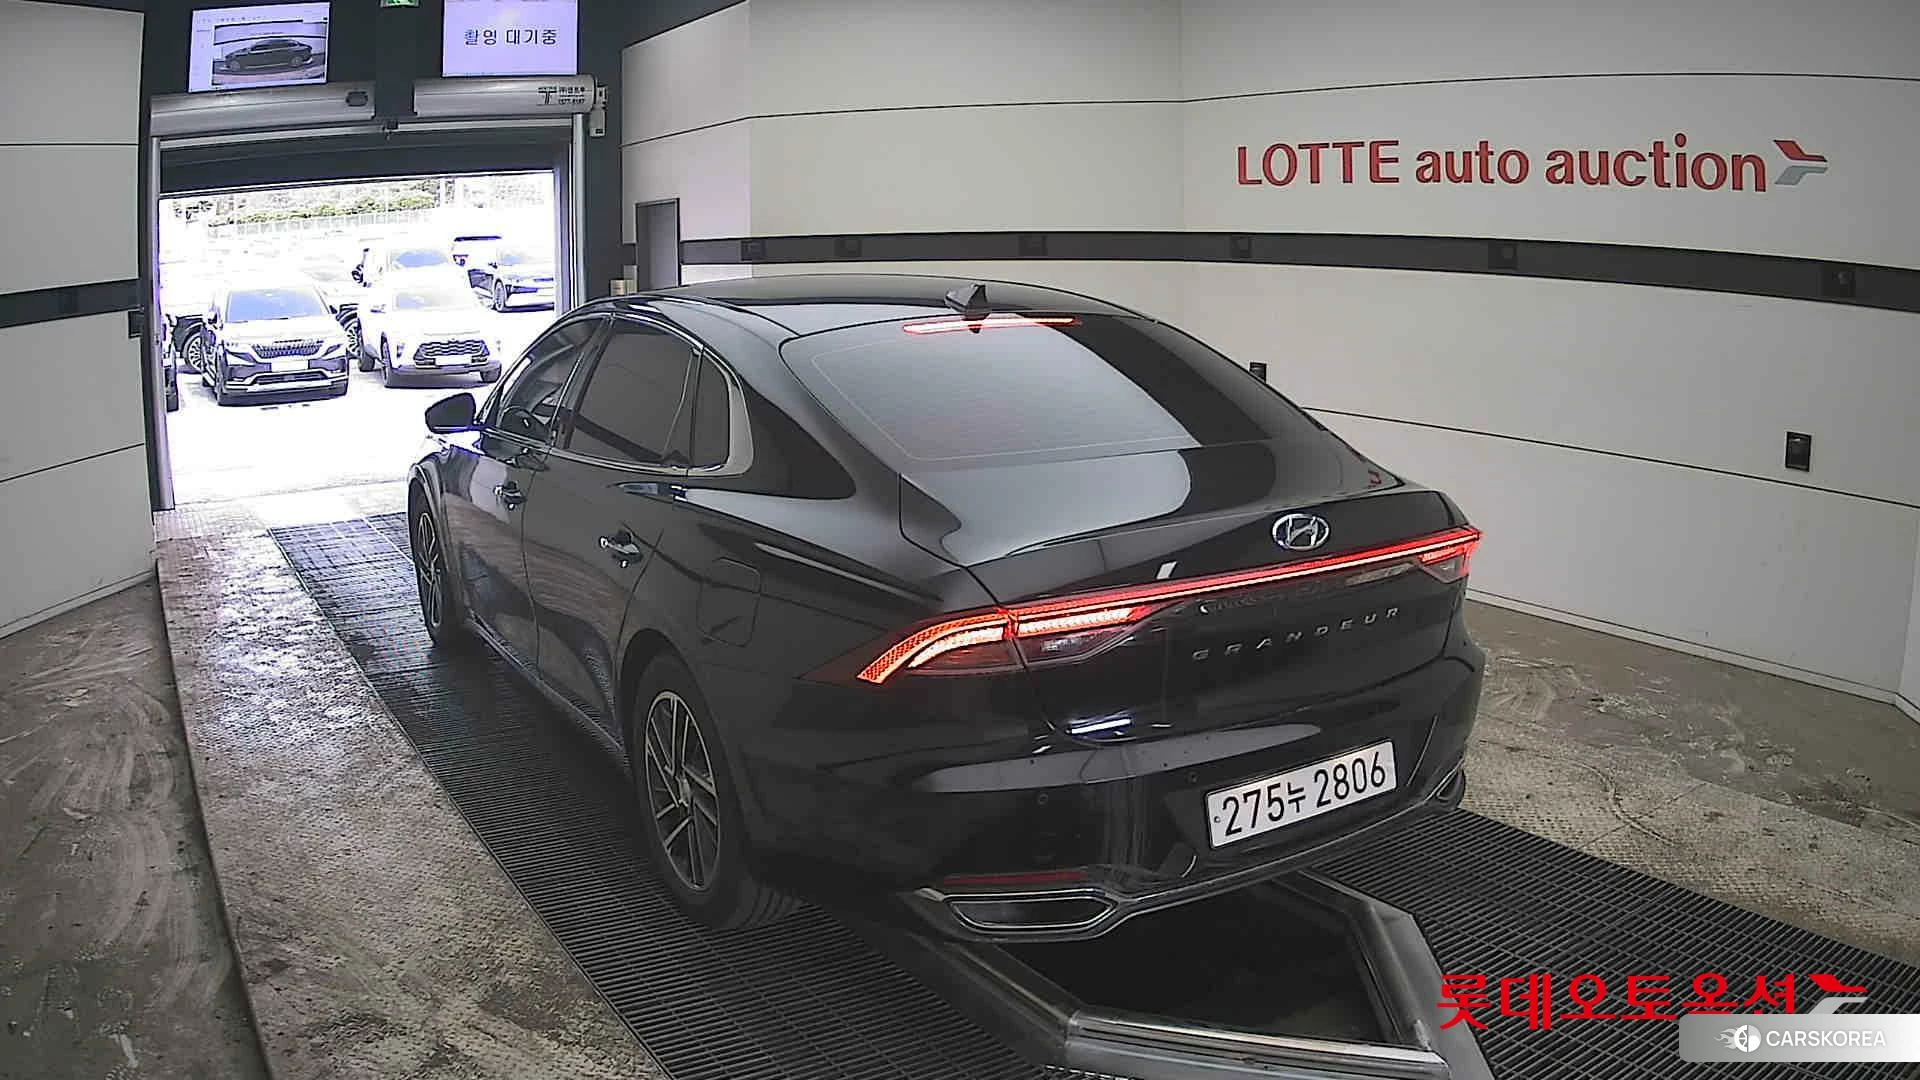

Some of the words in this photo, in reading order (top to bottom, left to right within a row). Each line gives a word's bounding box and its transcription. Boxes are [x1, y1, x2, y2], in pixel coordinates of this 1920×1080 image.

[505, 29, 557, 45] 대기중
[1236, 140, 1400, 186] LOTTE
[1415, 140, 1530, 185] auto
[1545, 133, 1767, 193] auction
[1192, 606, 1400, 661] GRANDEUR
[1222, 781, 1307, 837] 275누
[1313, 751, 1387, 809] 2806
